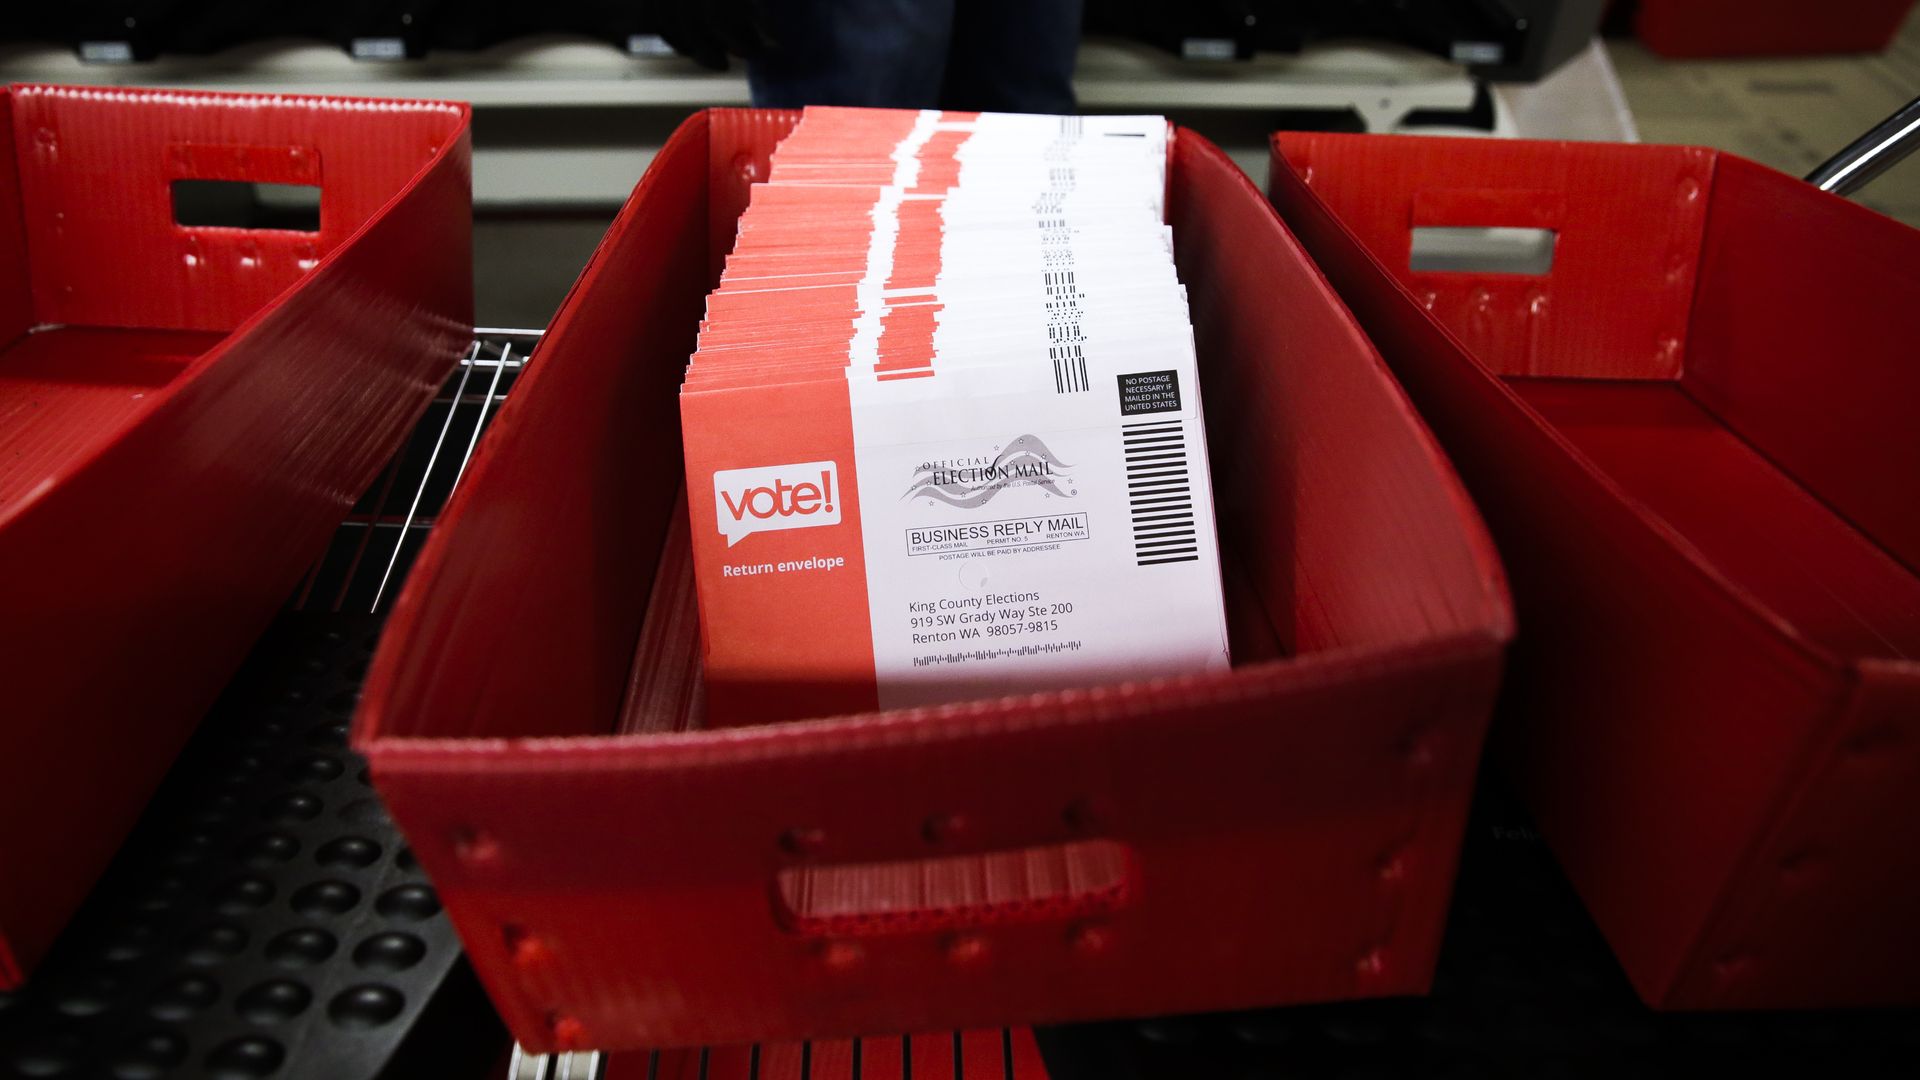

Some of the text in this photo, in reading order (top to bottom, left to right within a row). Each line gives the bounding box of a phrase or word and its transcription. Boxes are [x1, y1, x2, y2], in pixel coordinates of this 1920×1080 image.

[1126, 384, 1164, 393] NECESSARY
[1138, 375, 1170, 384] POSTAGE
[1124, 394, 1151, 402] MAILED
[1124, 400, 1177, 411] UNITED STATES
[922, 456, 989, 470] OFFICIAL
[933, 461, 1054, 486] ELECTION MAIL
[720, 470, 834, 521] vote!
[911, 517, 1084, 544] BUSINESS REPLY MAIL
[912, 543, 952, 552] FIRST-CLASS
[986, 537, 1010, 545] PERMIT
[1022, 544, 1061, 553] ADDRESSEE
[723, 556, 844, 577] Return envelope
[909, 592, 1040, 614] King County Elections
[911, 602, 1073, 628] 919 SW Grady Way Ste 200
[912, 620, 1058, 644] Renton WA 98057-9815
